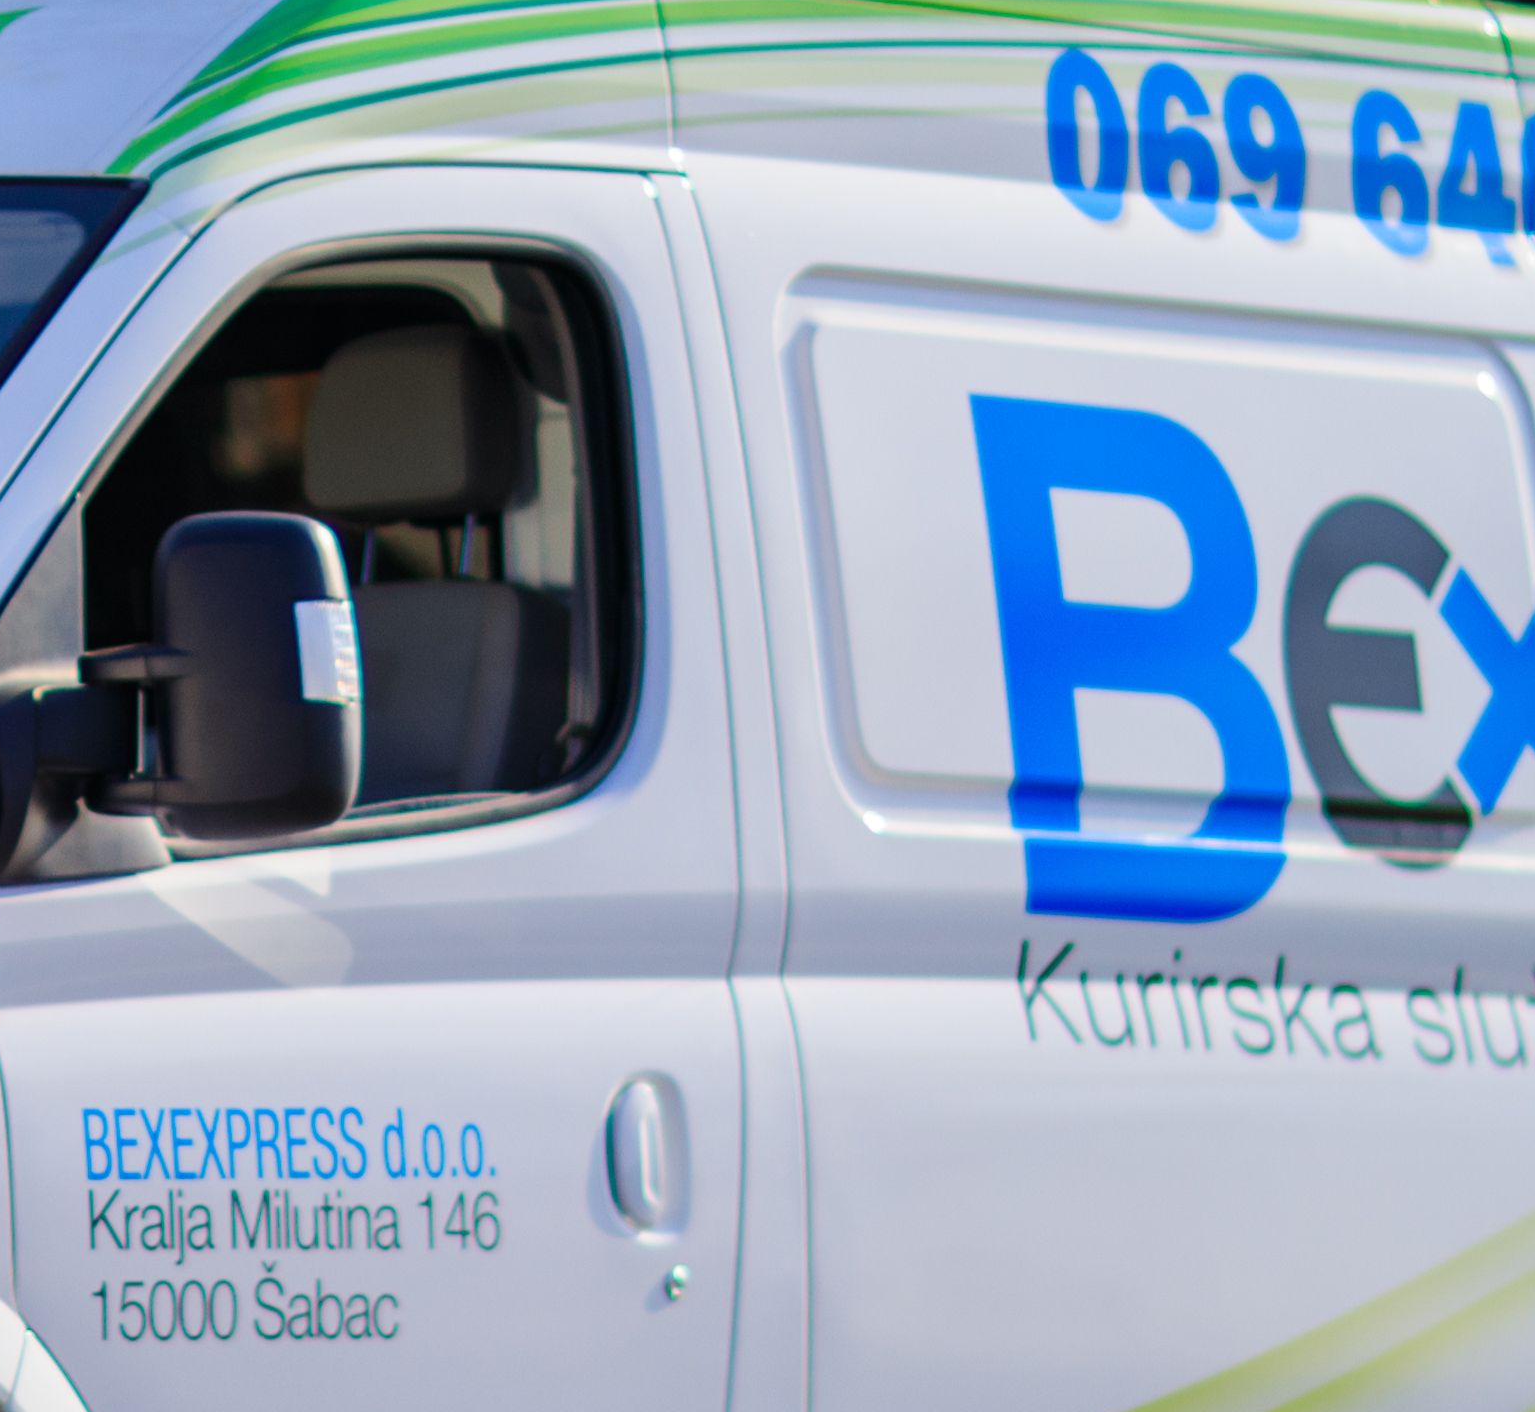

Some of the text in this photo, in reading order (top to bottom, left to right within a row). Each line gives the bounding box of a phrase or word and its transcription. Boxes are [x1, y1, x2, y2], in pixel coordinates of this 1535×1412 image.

[1046, 47, 1306, 240] 069
[1016, 938, 1383, 1061] Kurirska
[82, 1106, 497, 1180] BEXEXPRESS d.o.o.
[88, 1188, 502, 1266] Kralja Milutina 146
[91, 1260, 400, 1342] 15000 Šabac
